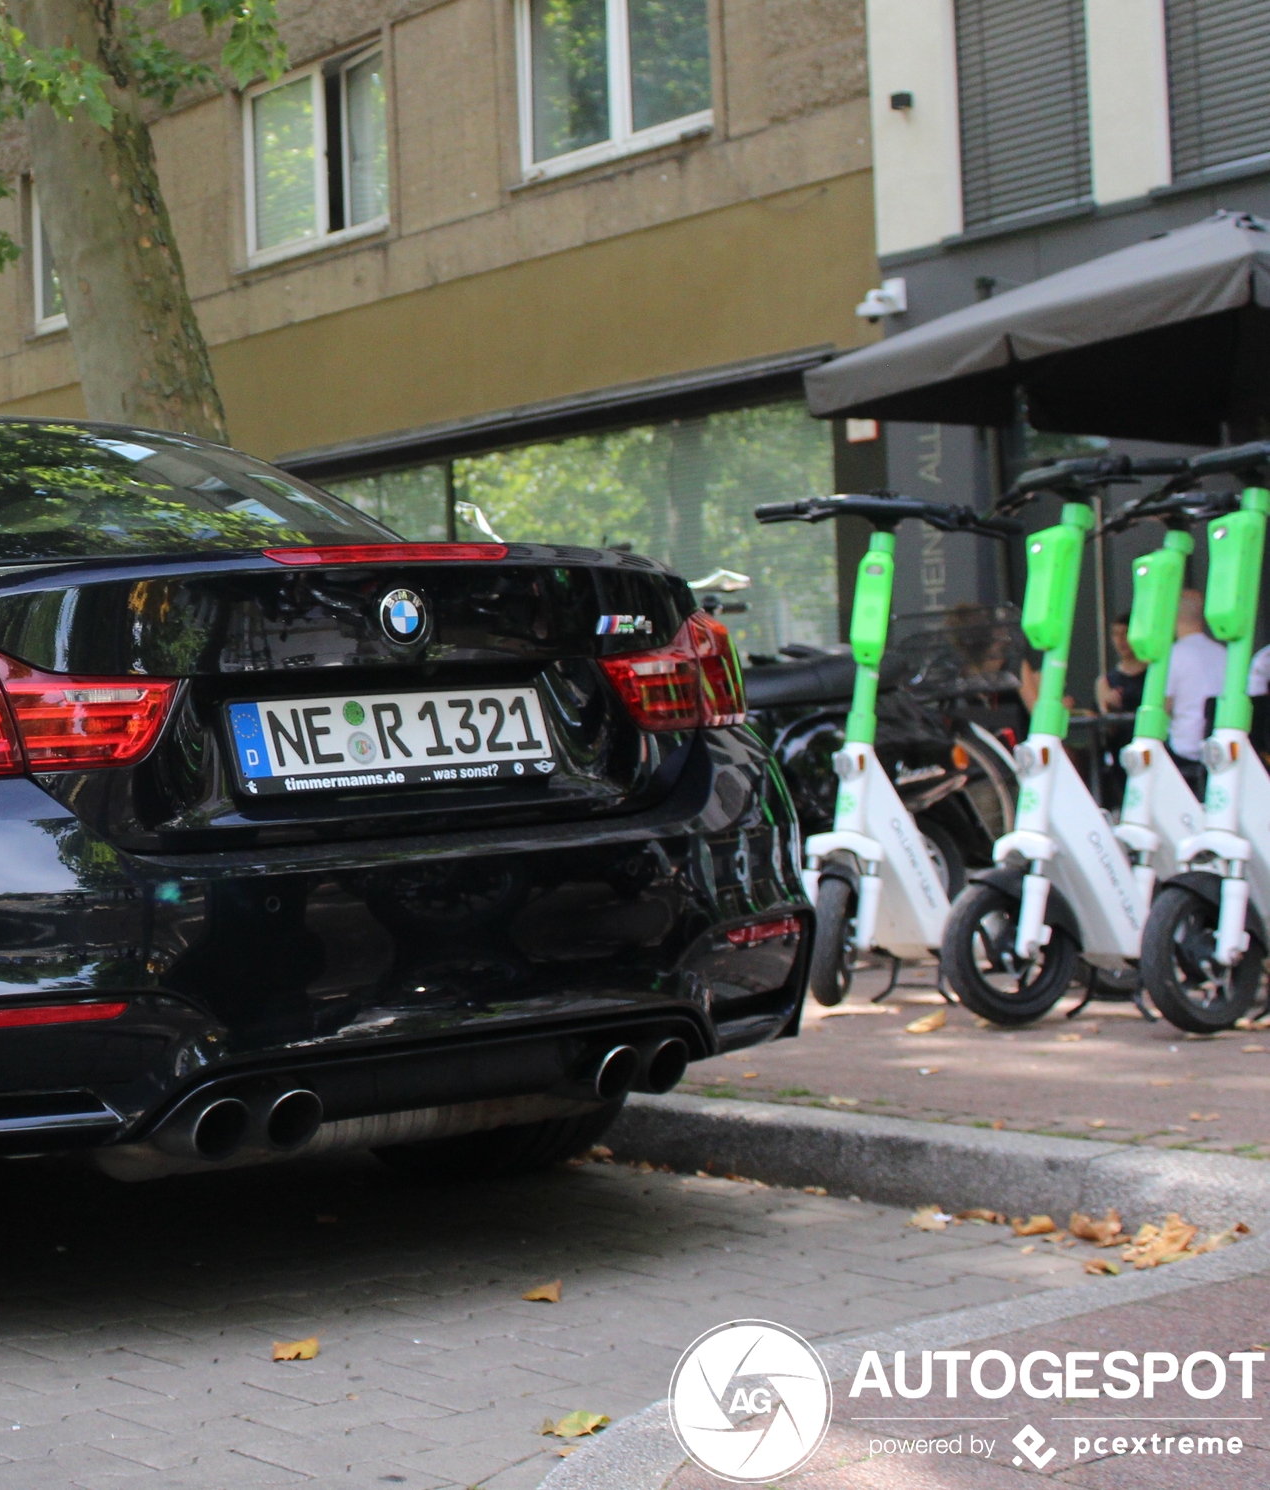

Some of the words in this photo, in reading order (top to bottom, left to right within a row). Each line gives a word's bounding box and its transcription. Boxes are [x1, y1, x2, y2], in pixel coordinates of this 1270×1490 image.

[385, 591, 422, 608] BMW
[267, 706, 344, 767] NE
[371, 702, 413, 760] R
[418, 696, 544, 757] 1321
[246, 749, 260, 767] D
[284, 770, 405, 792] timmermanns.de
[432, 769, 457, 780] was
[459, 764, 498, 778] sonst?
